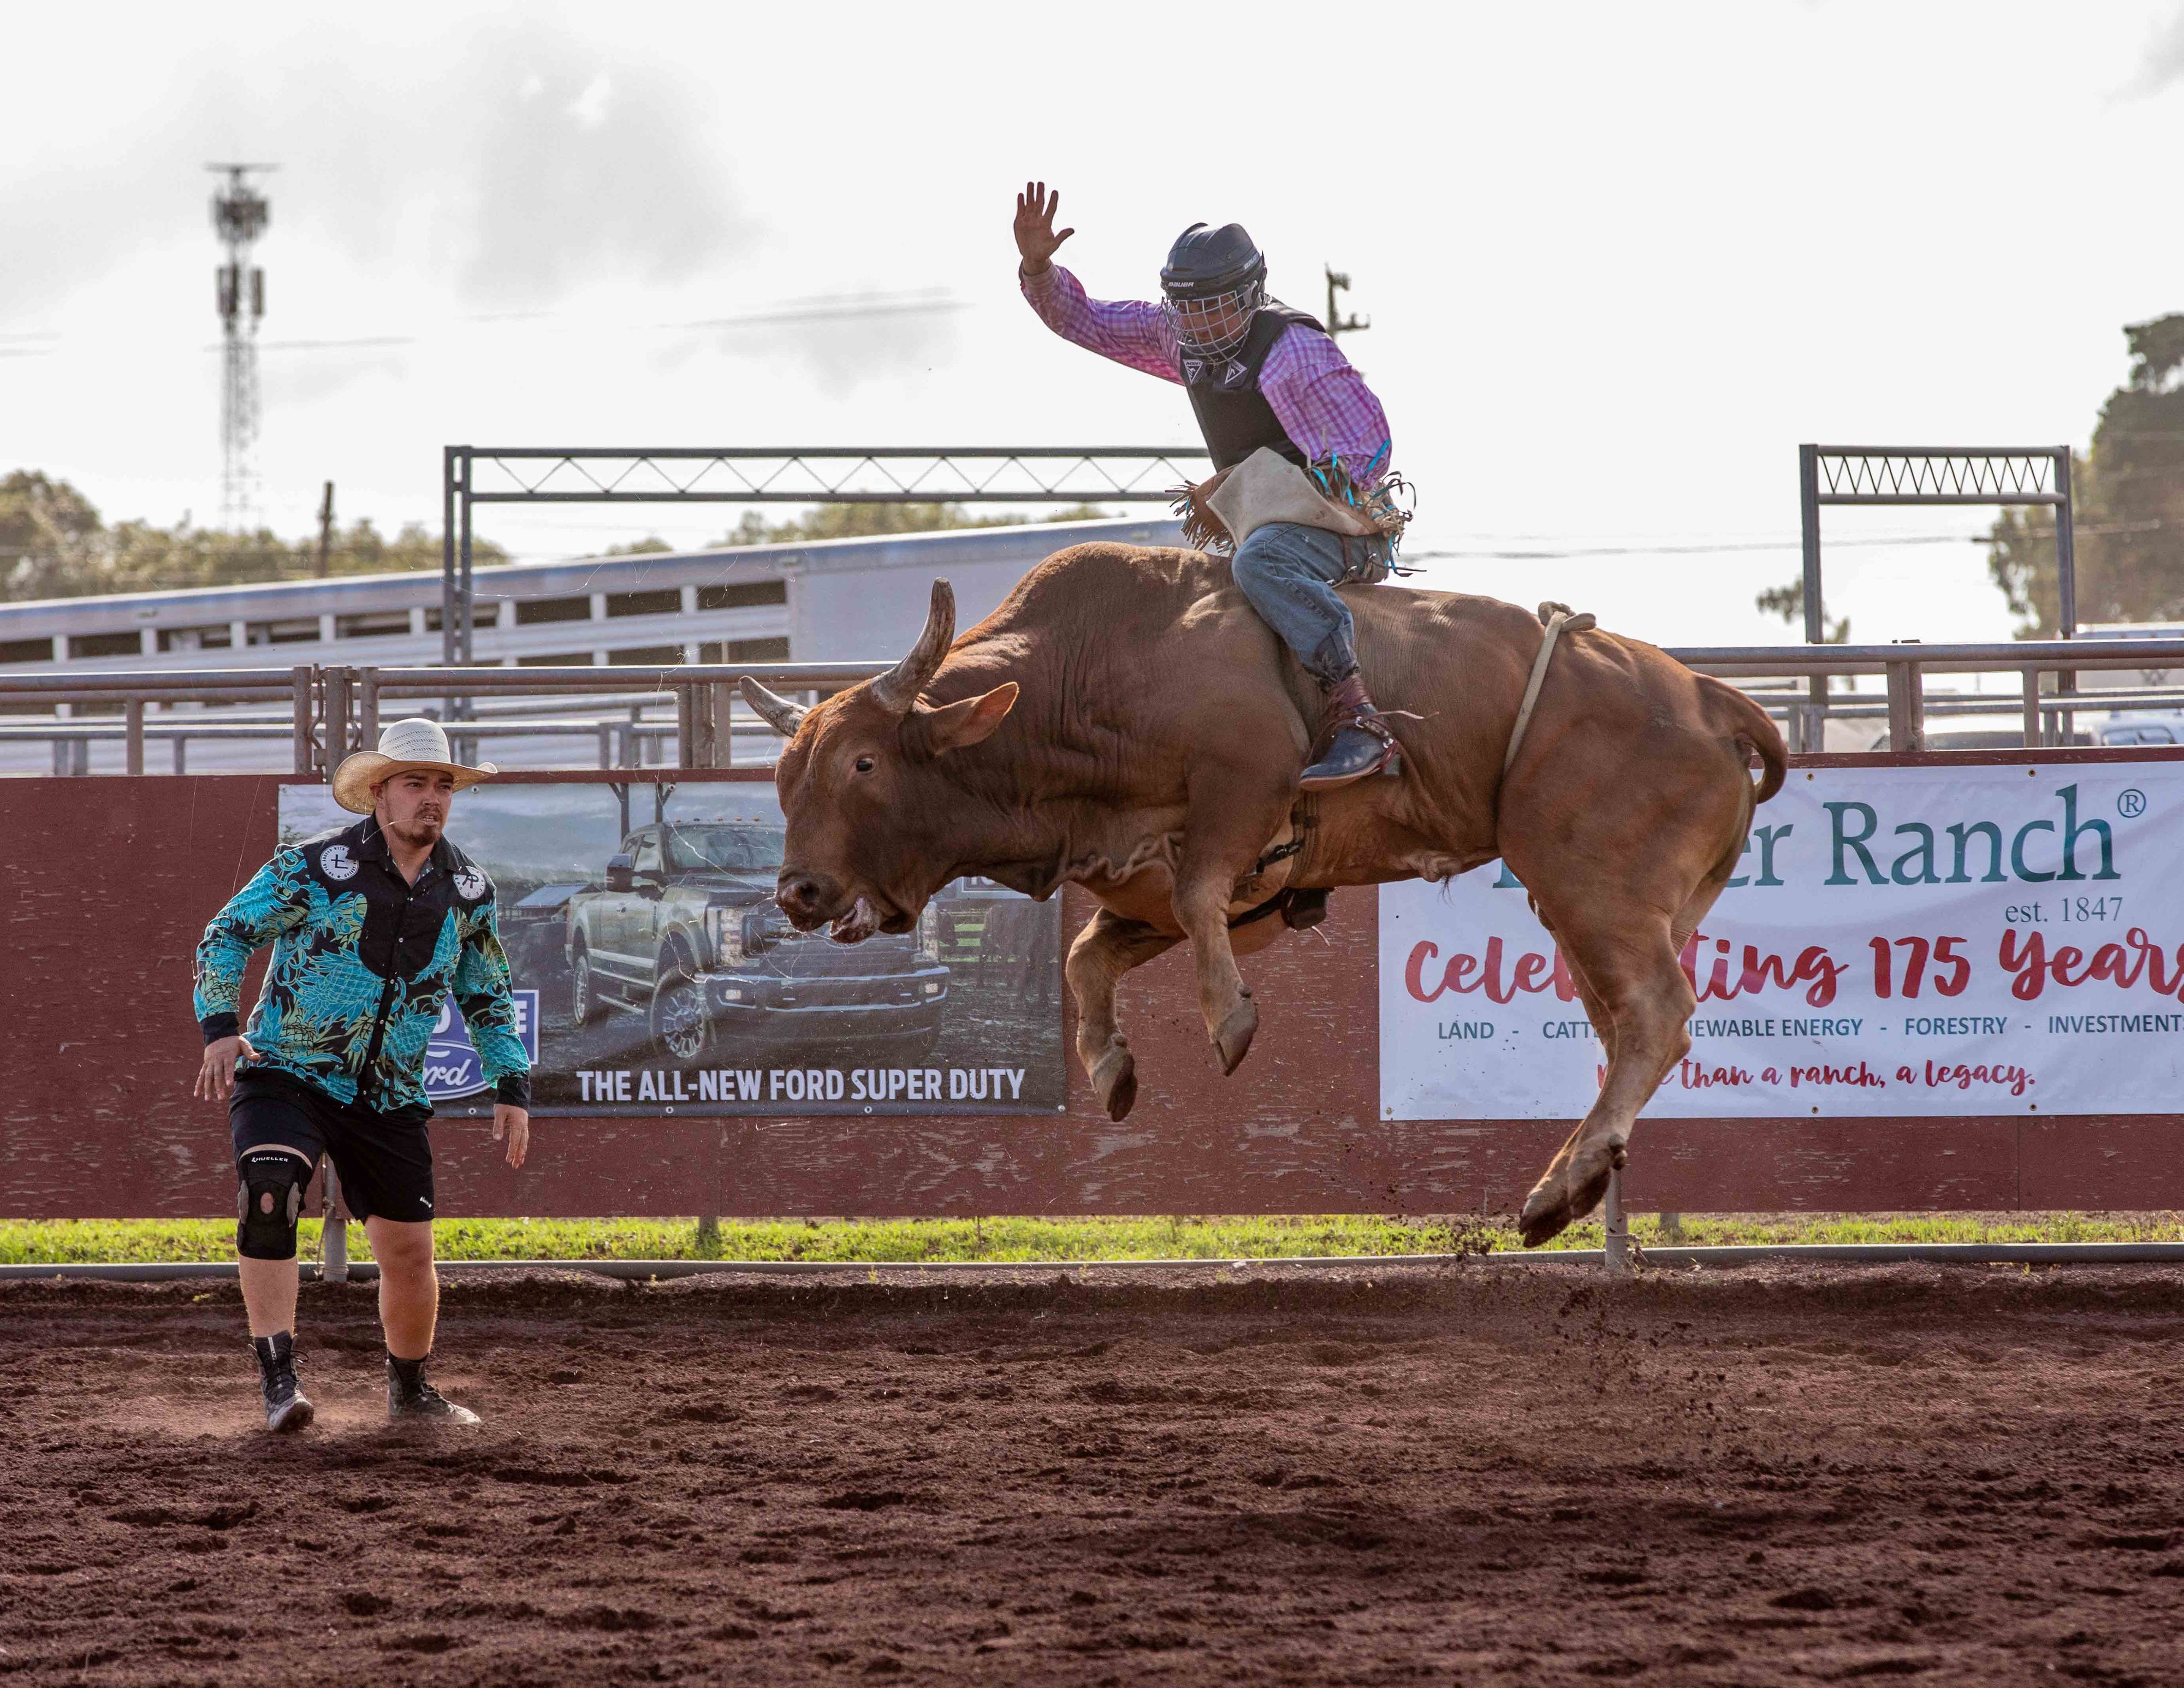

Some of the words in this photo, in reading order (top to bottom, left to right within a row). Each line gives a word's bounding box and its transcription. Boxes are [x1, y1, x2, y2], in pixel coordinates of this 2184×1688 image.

[2005, 902, 2048, 923] est.
[2062, 897, 2123, 922] 1847
[1869, 936, 1971, 999] 175
[1439, 1021, 1494, 1039] LAND
[1782, 1018, 1863, 1037] ENERGY
[1906, 1017, 2008, 1035] FORESTRY
[576, 1070, 631, 1101] THE
[638, 1069, 762, 1101] ALL-NEW
[770, 1069, 844, 1100] FORD
[851, 1068, 942, 1100] SUPER
[949, 1068, 1026, 1099] DUTY
[1680, 1059, 1754, 1089] than
[1761, 1067, 1783, 1085] a
[1791, 1062, 1885, 1088] ranch,
[1896, 1066, 1917, 1084] a
[1926, 1060, 2035, 1096] legacy.
